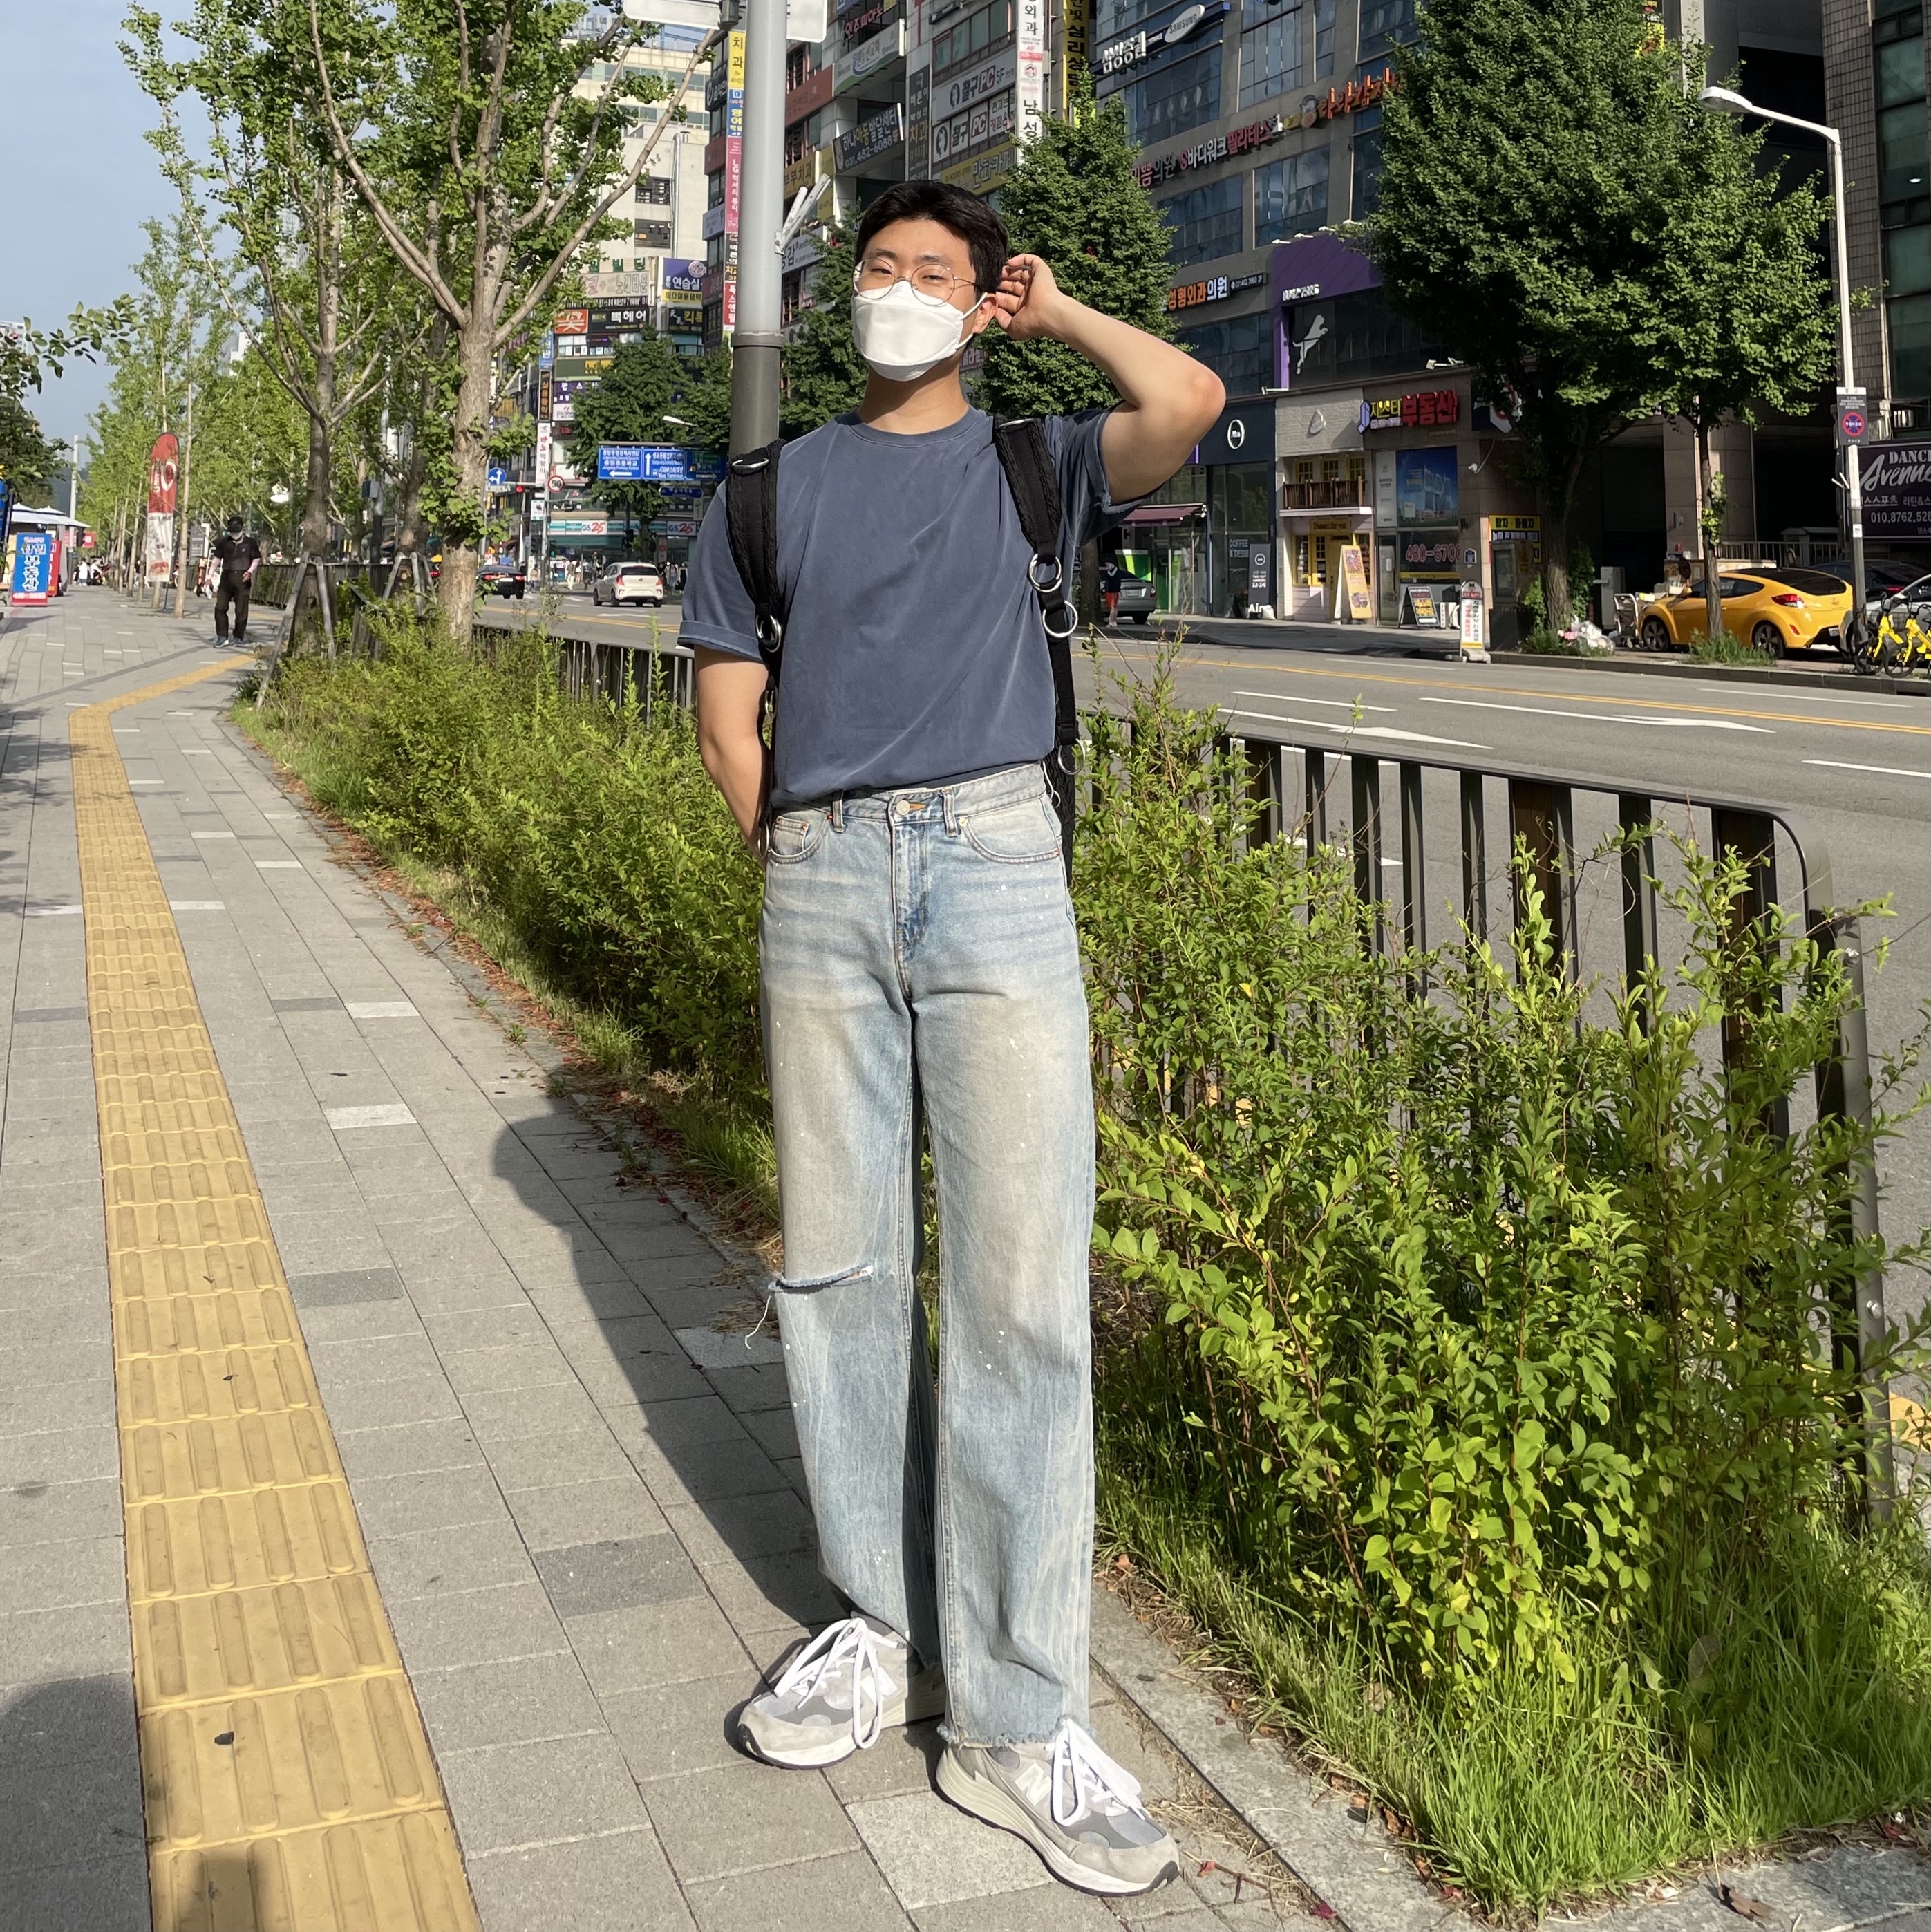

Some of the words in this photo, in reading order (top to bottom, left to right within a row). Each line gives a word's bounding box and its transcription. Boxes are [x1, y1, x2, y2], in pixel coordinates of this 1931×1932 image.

[1025, 0, 1038, 35] 외과
[1169, 13, 1197, 34] SAMSUNG
[733, 37, 744, 68] 치과
[1102, 30, 1147, 74] 삼성증권
[996, 68, 1004, 84] 5F
[842, 107, 897, 151] 하나아동발달센터
[909, 119, 927, 144] 치과
[972, 113, 986, 136] PC
[845, 136, 892, 168] 031.482-6088
[972, 147, 1017, 191] 만화카페
[672, 276, 699, 290] 연습실
[1167, 275, 1228, 311] 성형외과의원
[1370, 399, 1401, 418] 지스타
[1402, 389, 1458, 427] 부동산
[552, 480, 562, 488] 50
[1861, 495, 1899, 507] 스스포츠
[582, 522, 606, 533] GS25
[668, 522, 695, 534] GS25
[1229, 539, 1248, 547] COFFEE
[22, 555, 40, 592] 부동산
[1015, 1763, 1052, 1806] N
